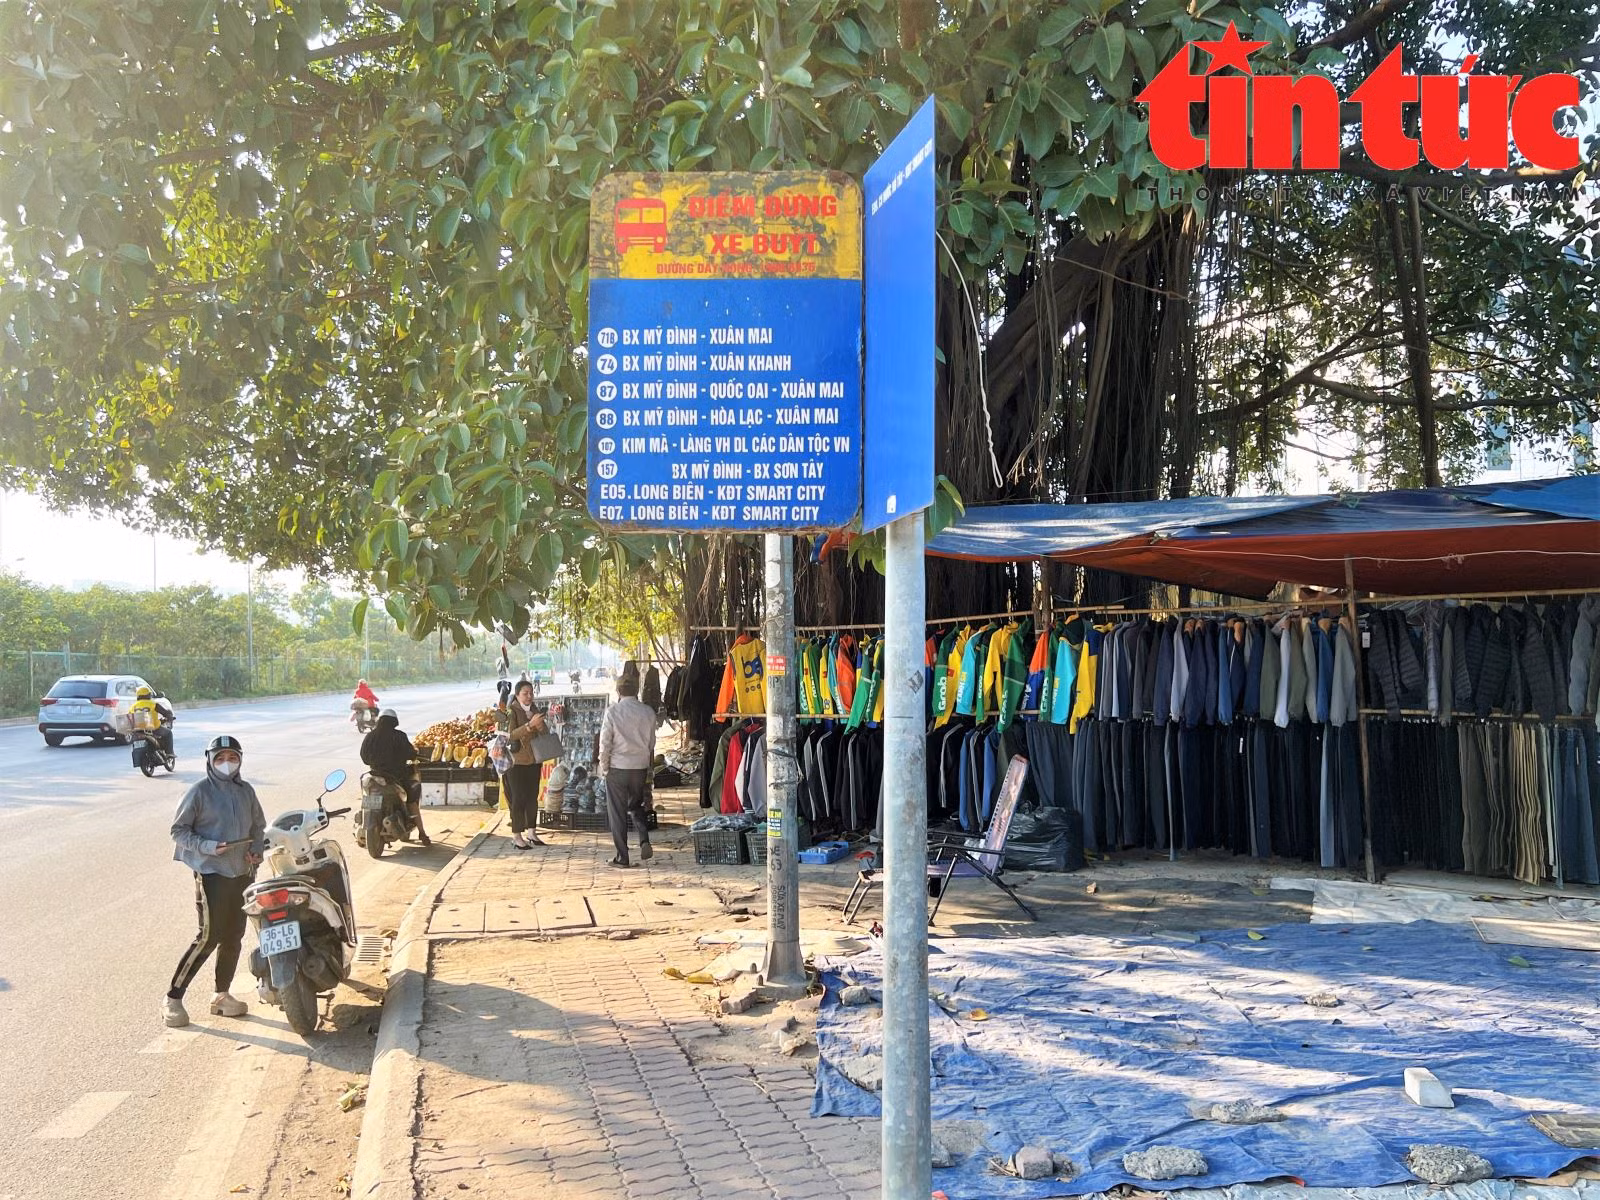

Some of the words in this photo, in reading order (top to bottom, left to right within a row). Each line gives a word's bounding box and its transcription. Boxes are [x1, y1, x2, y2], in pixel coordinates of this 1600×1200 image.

[711, 233, 743, 255] XE
[622, 329, 640, 345] BX
[643, 325, 663, 345] MỸ
[666, 325, 697, 345] ĐÌNH
[709, 324, 745, 345] XUÂN
[747, 327, 773, 345] MAI
[600, 358, 615, 373] 74
[622, 355, 640, 372] BX
[643, 351, 663, 371] MỸ
[666, 351, 697, 371] ĐÌNH
[709, 351, 745, 371] XUÂN
[748, 355, 792, 371] KHANH
[599, 385, 615, 399] 87
[622, 382, 640, 399] BX
[643, 379, 663, 399] MỸ
[666, 379, 697, 399] ĐÌNH
[709, 378, 744, 401] QUỐC
[747, 382, 769, 399] OAI
[781, 378, 816, 399] XUÂN
[819, 382, 844, 398] MAI
[599, 412, 614, 426] 88
[623, 410, 641, 426] BX
[643, 406, 664, 426] MỸ
[666, 406, 698, 426] ĐÌNH
[710, 406, 736, 425] HÒA
[739, 408, 763, 429] LẠC
[775, 405, 810, 425] XUÂN
[814, 407, 839, 424] MAI
[622, 437, 646, 454] KIM
[680, 433, 712, 453] LÀNG
[714, 437, 731, 453] VH
[733, 436, 749, 453] DL
[751, 433, 776, 453] CÁC
[779, 432, 804, 453] DÂN
[807, 432, 830, 456] TỘC
[833, 436, 850, 453] VN
[600, 463, 615, 476] 157
[671, 463, 688, 479] BX
[691, 459, 710, 479] MỸ
[712, 460, 743, 479] ĐÌNH
[753, 463, 770, 479] BX
[773, 462, 799, 479] SƠN
[801, 458, 824, 479] TÂY
[600, 483, 632, 500] E05.
[633, 484, 669, 500] LONG
[672, 481, 704, 500] BIÊN
[717, 485, 743, 501] KĐT
[746, 485, 793, 501] SMART
[796, 485, 826, 501] CITY
[598, 505, 624, 521] E07.
[629, 505, 665, 521] LONG
[668, 501, 699, 521] BIÊN
[711, 505, 737, 520] KĐT
[742, 505, 788, 521] SMART
[791, 506, 819, 521] CITY
[937, 676, 947, 711] Grab
[265, 924, 294, 941] 36-L6
[263, 935, 298, 955] 049.51
